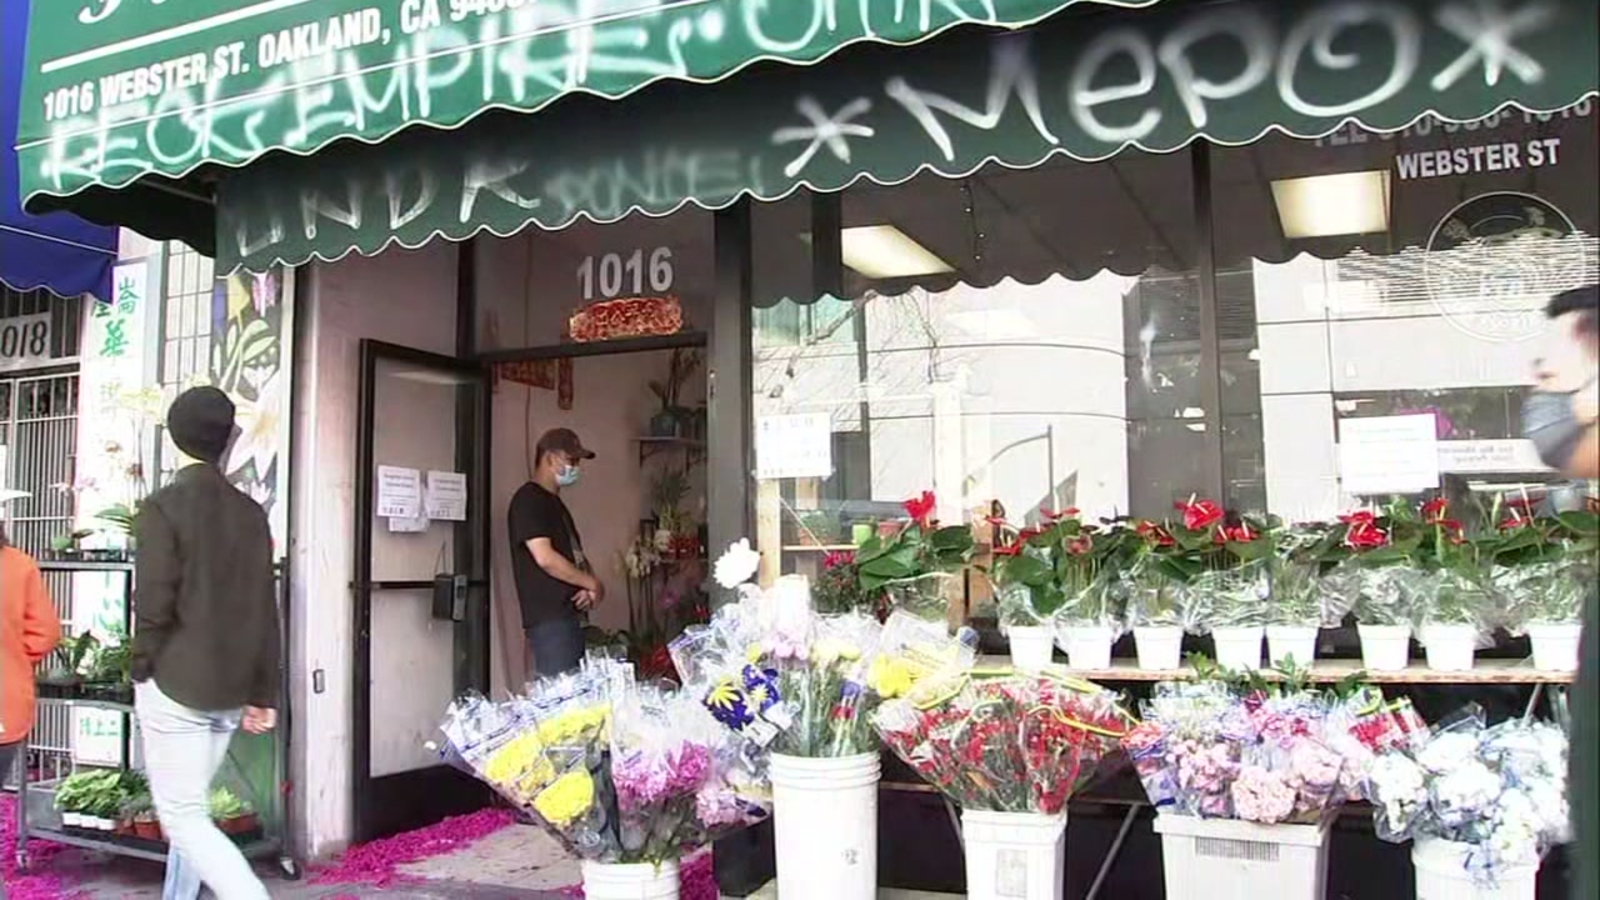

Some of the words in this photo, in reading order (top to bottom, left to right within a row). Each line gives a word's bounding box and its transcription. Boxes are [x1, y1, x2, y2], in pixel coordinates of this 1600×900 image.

[44, 81, 95, 121] 1016
[100, 52, 207, 107] WEBSTER
[213, 41, 250, 80] ST.
[258, 7, 391, 68] OAKLAND,
[401, 0, 441, 34] CA
[1396, 143, 1521, 180] WEBSTER
[1527, 138, 1561, 166] ST
[576, 246, 674, 300] 1016
[1, 321, 48, 359] 018
